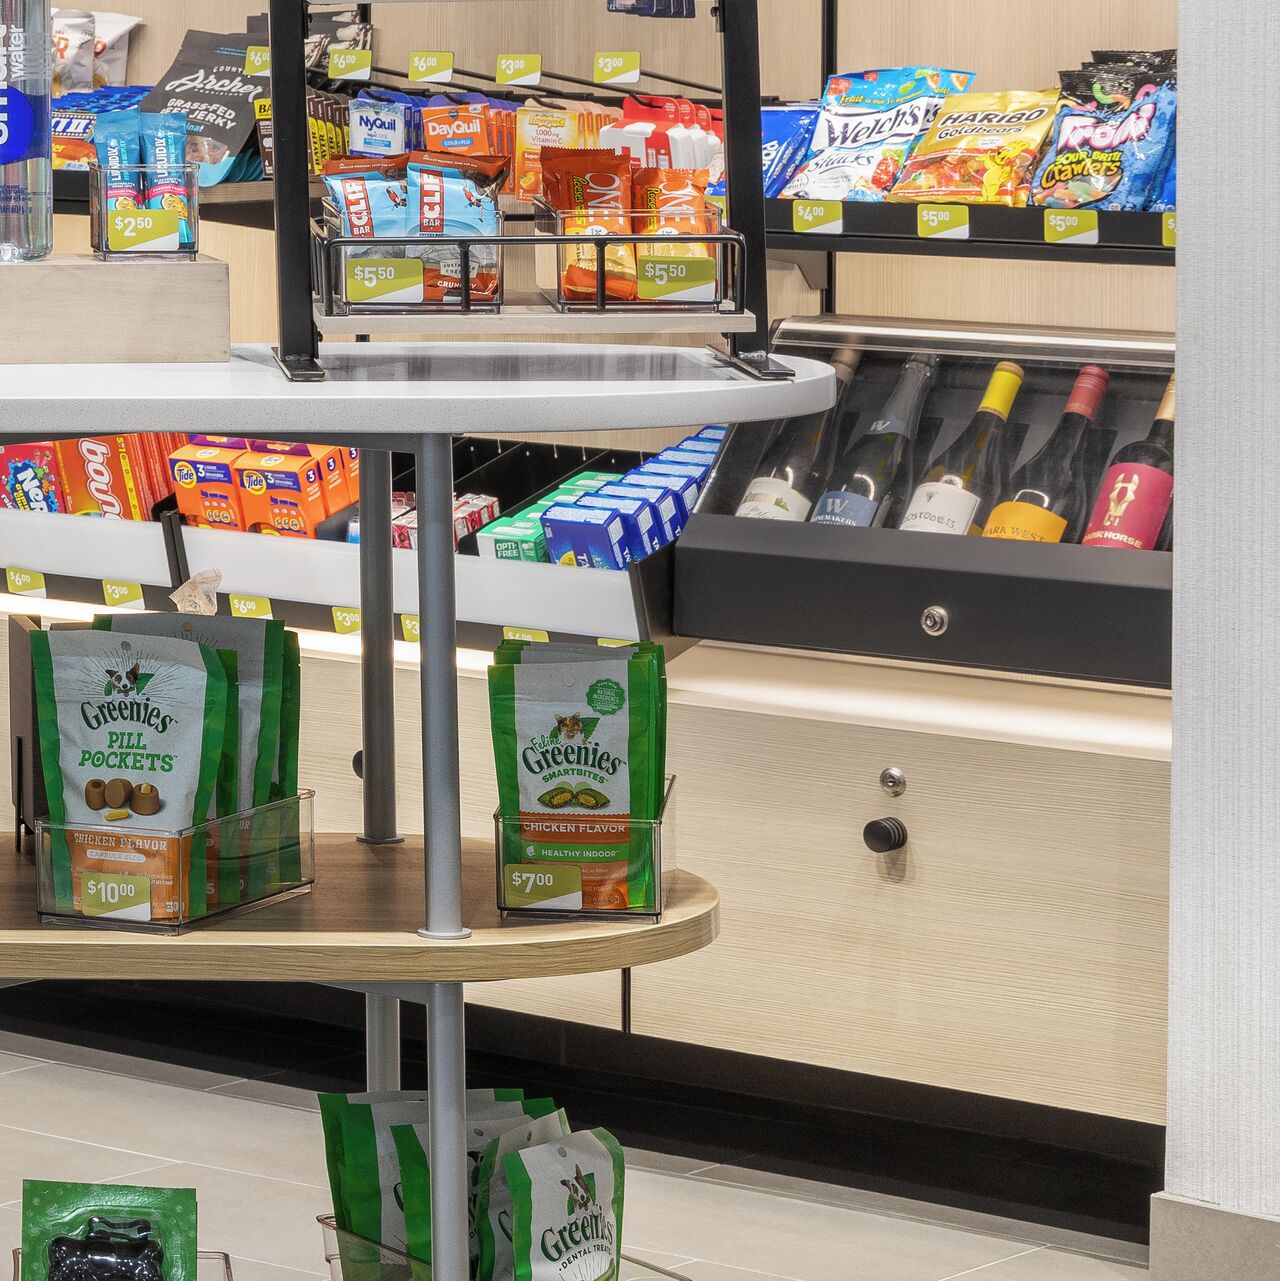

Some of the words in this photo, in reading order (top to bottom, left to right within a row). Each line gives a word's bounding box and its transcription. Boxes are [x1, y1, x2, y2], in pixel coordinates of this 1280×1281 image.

[9, 24, 24, 81] water
[165, 69, 263, 102] Archer
[166, 98, 236, 120] GRASS-FED
[191, 113, 236, 130] JERKY
[359, 115, 397, 132] NyQuil
[825, 104, 922, 147] Welch's
[939, 109, 1045, 127] HARIBO
[428, 120, 481, 137] DayQuil
[937, 124, 1025, 140] Goldbears
[1042, 160, 1122, 188] Crawlers
[423, 172, 442, 216] CLIF
[353, 227, 371, 235] BAR
[423, 219, 441, 227] BAR
[176, 468, 195, 482] Tide
[246, 476, 264, 490] Tide
[1102, 531, 1143, 549] HORSE
[80, 697, 173, 733] Greenies
[107, 731, 147, 750] PILL
[79, 751, 174, 773] POCKETS
[522, 742, 623, 776] Greenies
[542, 768, 605, 784] SMARTBITES
[524, 823, 575, 833] CHICKEN
[579, 824, 625, 833] FLAVOR
[90, 852, 120, 860] CAPSULE
[542, 849, 581, 858] HEALTHY
[583, 850, 617, 858] INDOOR
